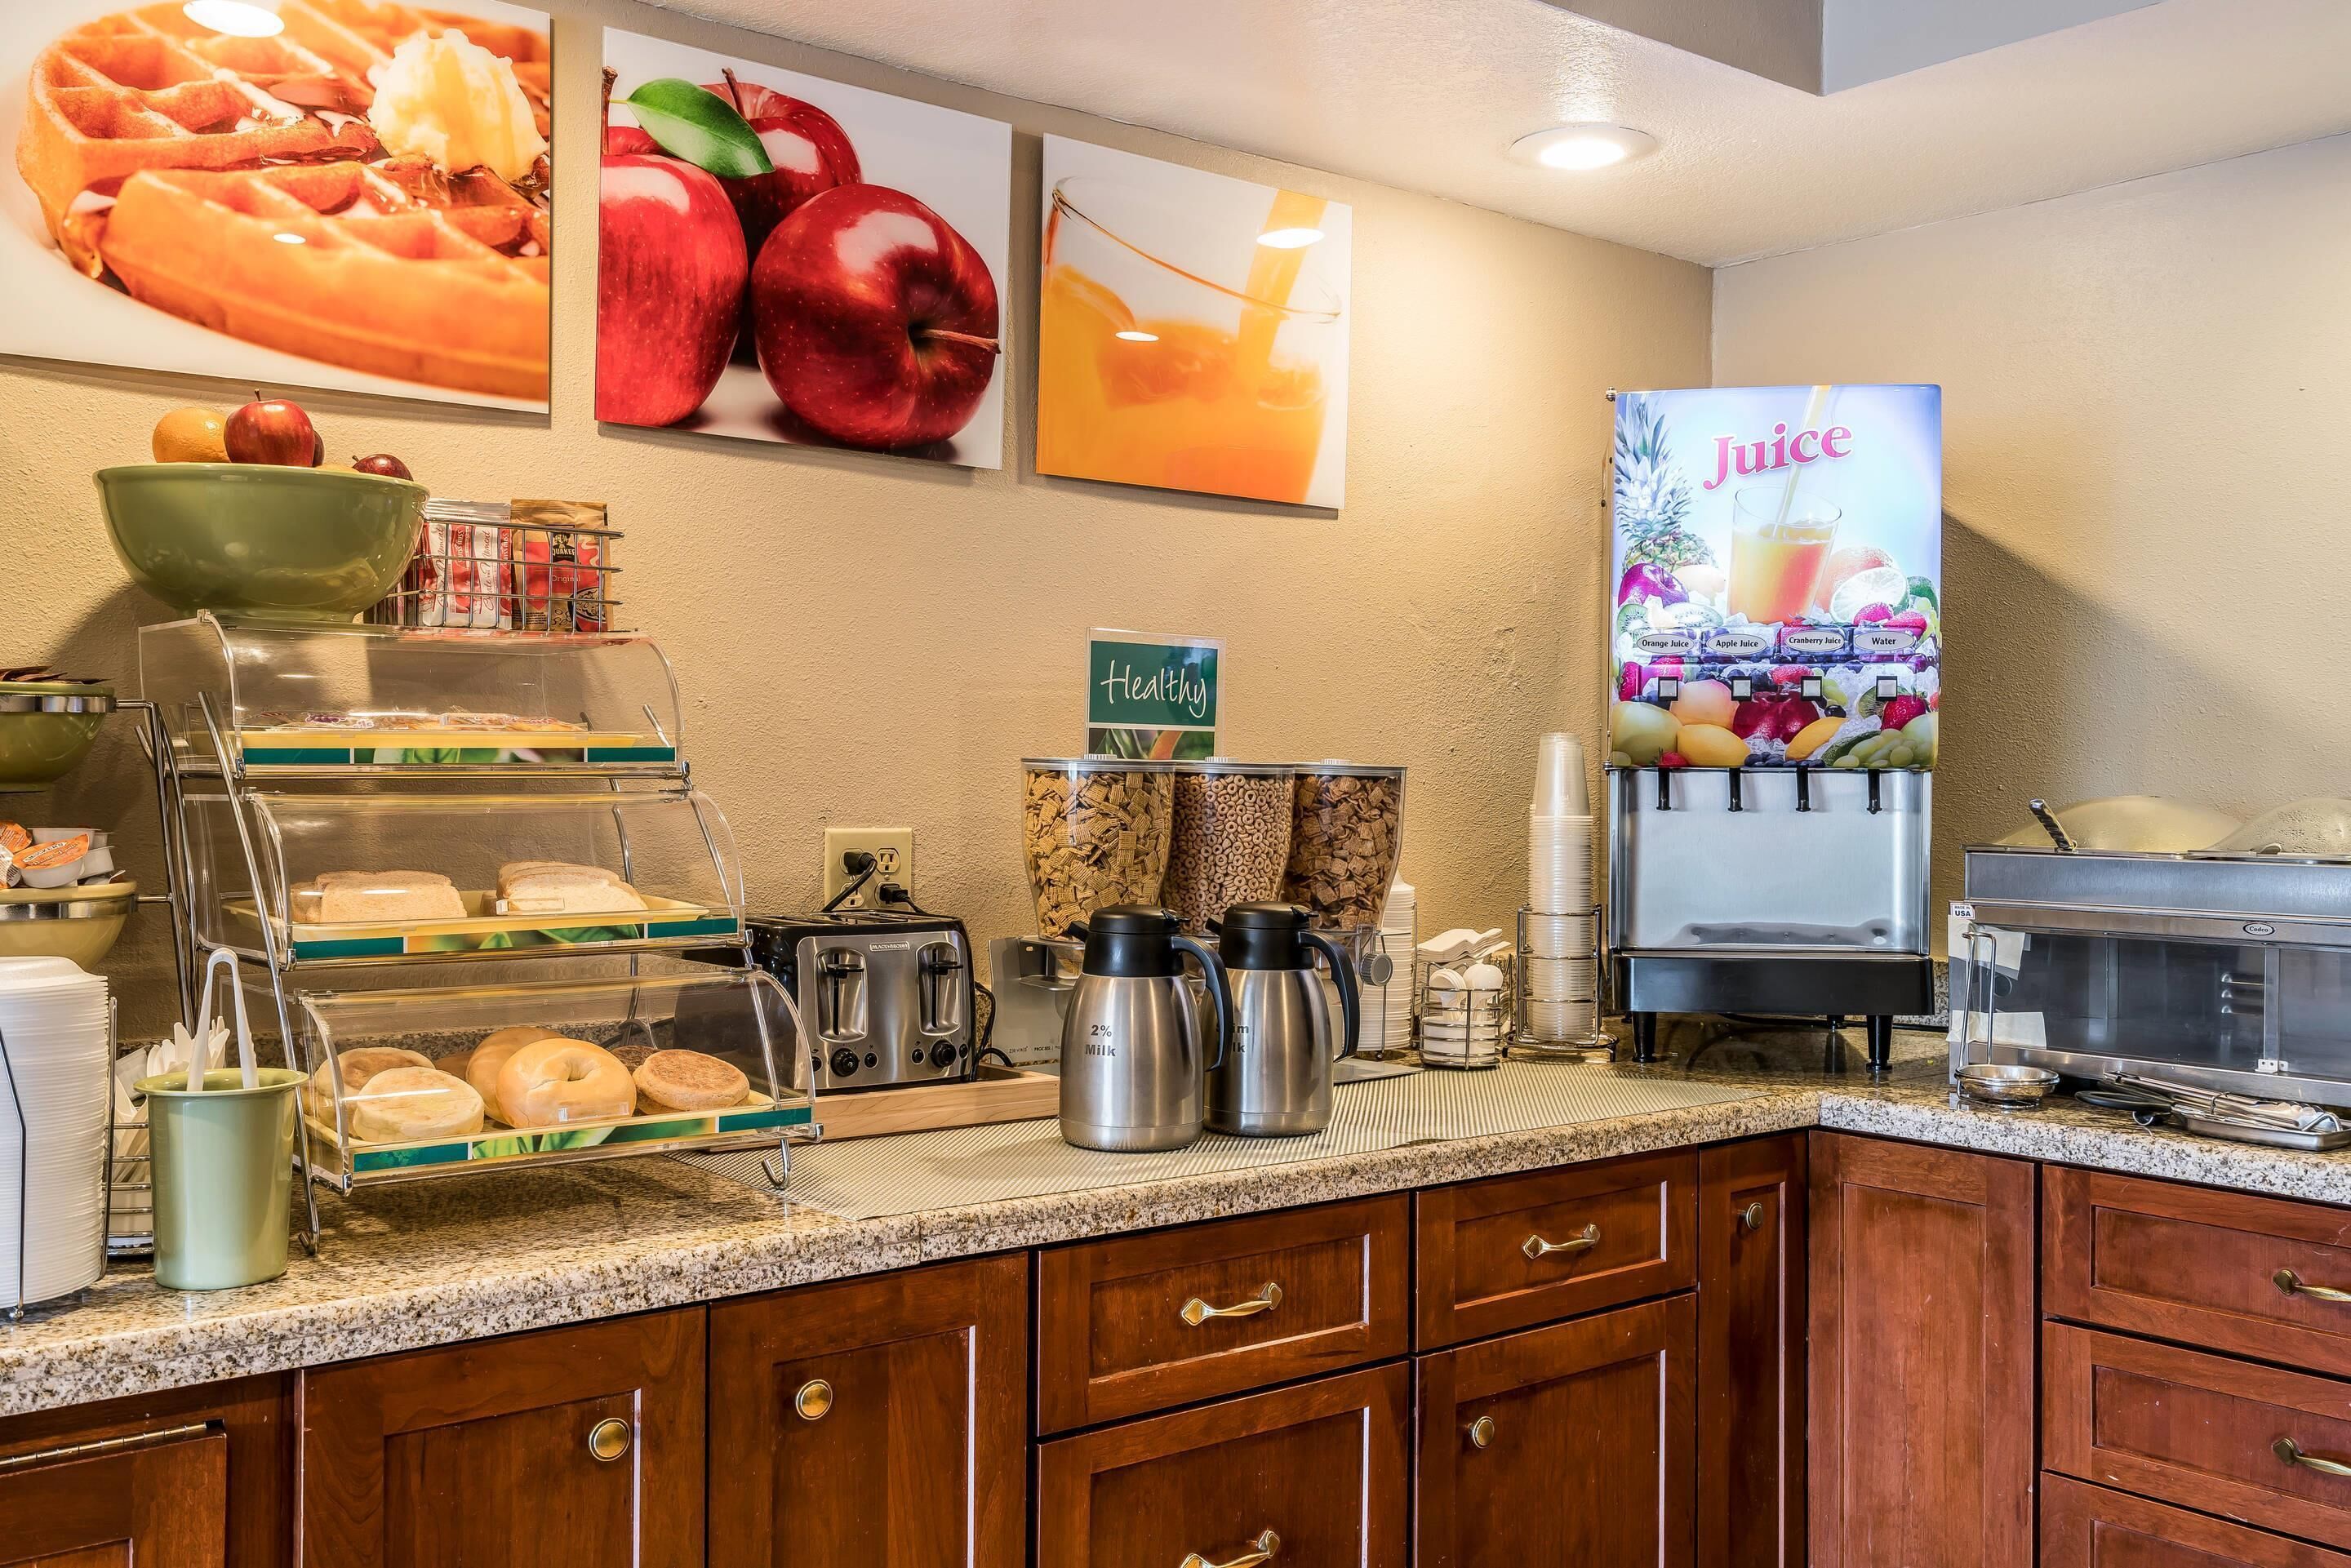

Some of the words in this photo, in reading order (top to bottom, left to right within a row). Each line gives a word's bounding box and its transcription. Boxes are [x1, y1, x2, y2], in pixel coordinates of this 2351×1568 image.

[1703, 423, 1852, 490] Juice
[482, 580, 494, 611] Crate
[1642, 639, 1669, 649] Orange
[1670, 639, 1689, 647] Juice
[1716, 639, 1738, 649] Apple
[1740, 639, 1758, 647] Juice
[1789, 637, 1824, 645] Cranberry
[1871, 637, 1896, 645] Water
[1100, 660, 1207, 718] Healthy
[1091, 1024, 1112, 1037] 2%
[1085, 1044, 1116, 1056] Milk
